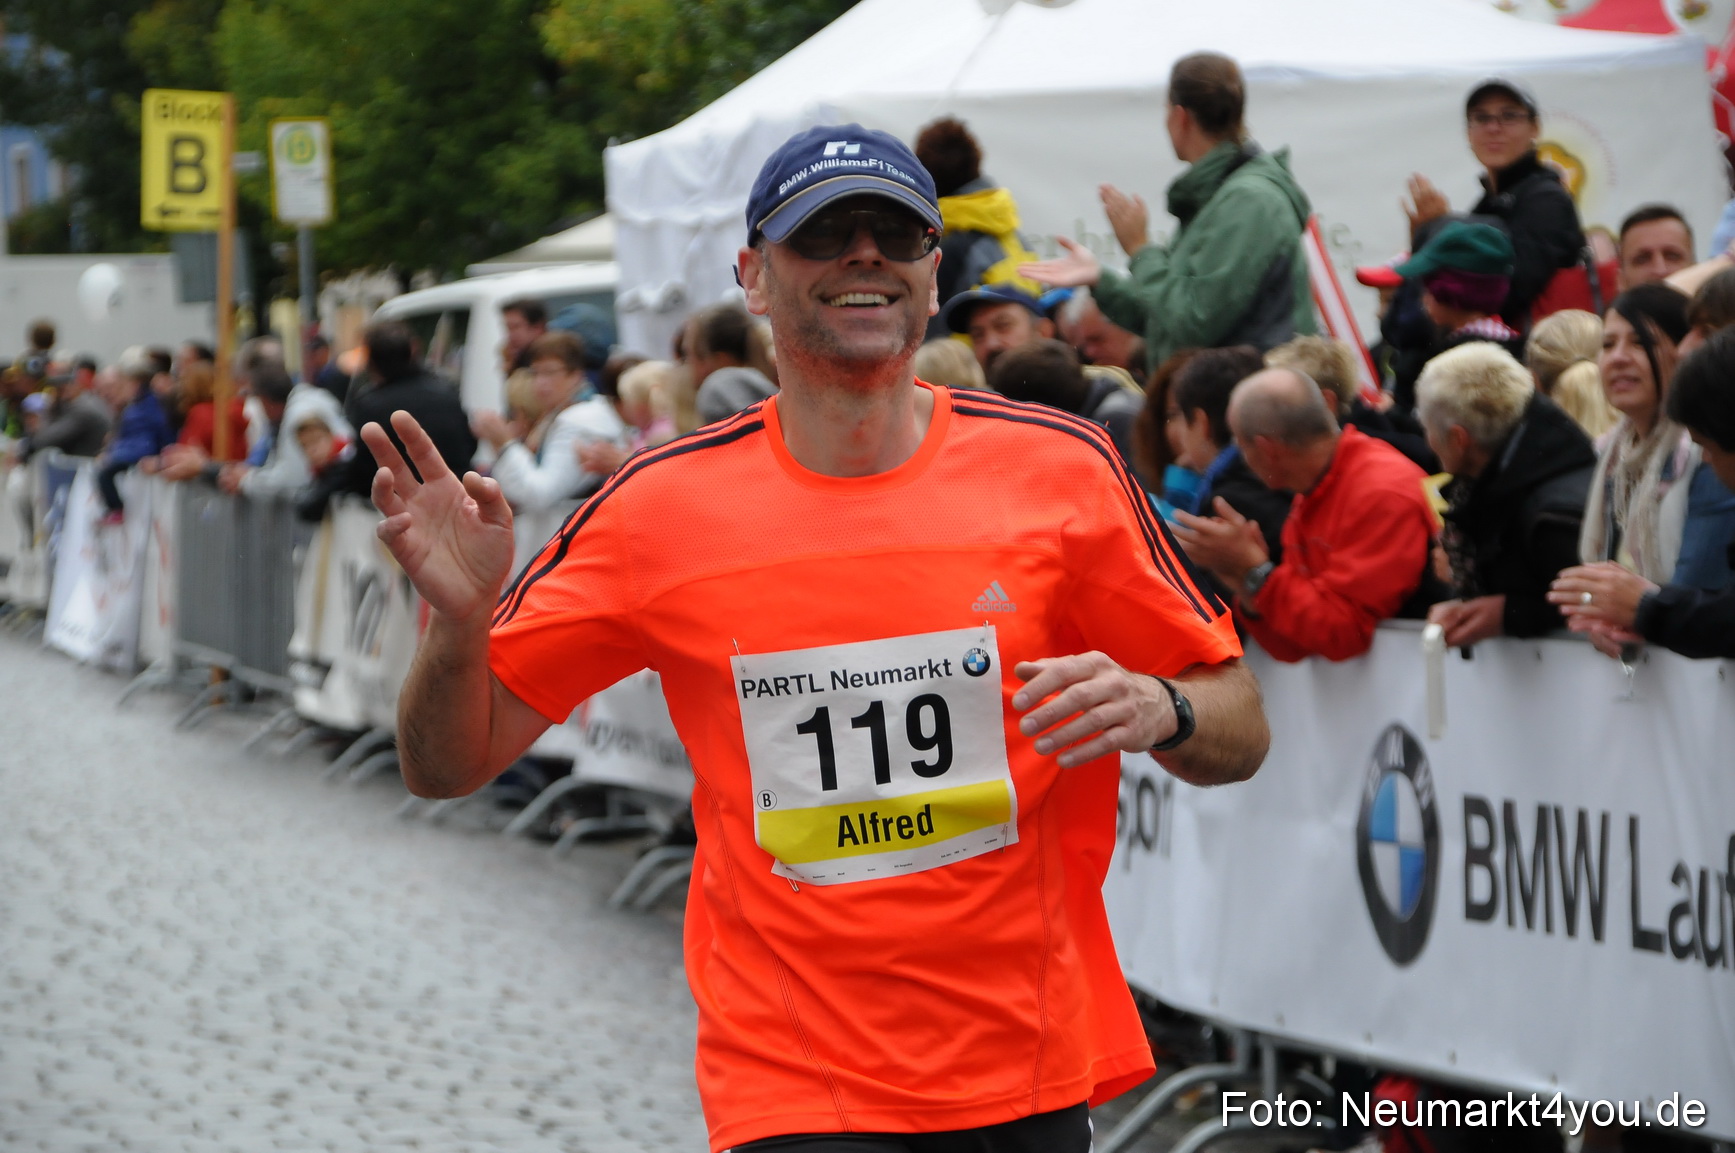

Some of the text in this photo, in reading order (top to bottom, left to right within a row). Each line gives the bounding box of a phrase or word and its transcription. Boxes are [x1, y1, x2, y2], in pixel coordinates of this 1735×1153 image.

[170, 135, 207, 194] B
[972, 600, 1017, 612] adidas
[741, 658, 952, 698] PARTL Neumarkt
[796, 693, 953, 791] 119
[762, 792, 772, 808] B
[838, 804, 934, 848] Alfred
[1462, 794, 1610, 944] BMW
